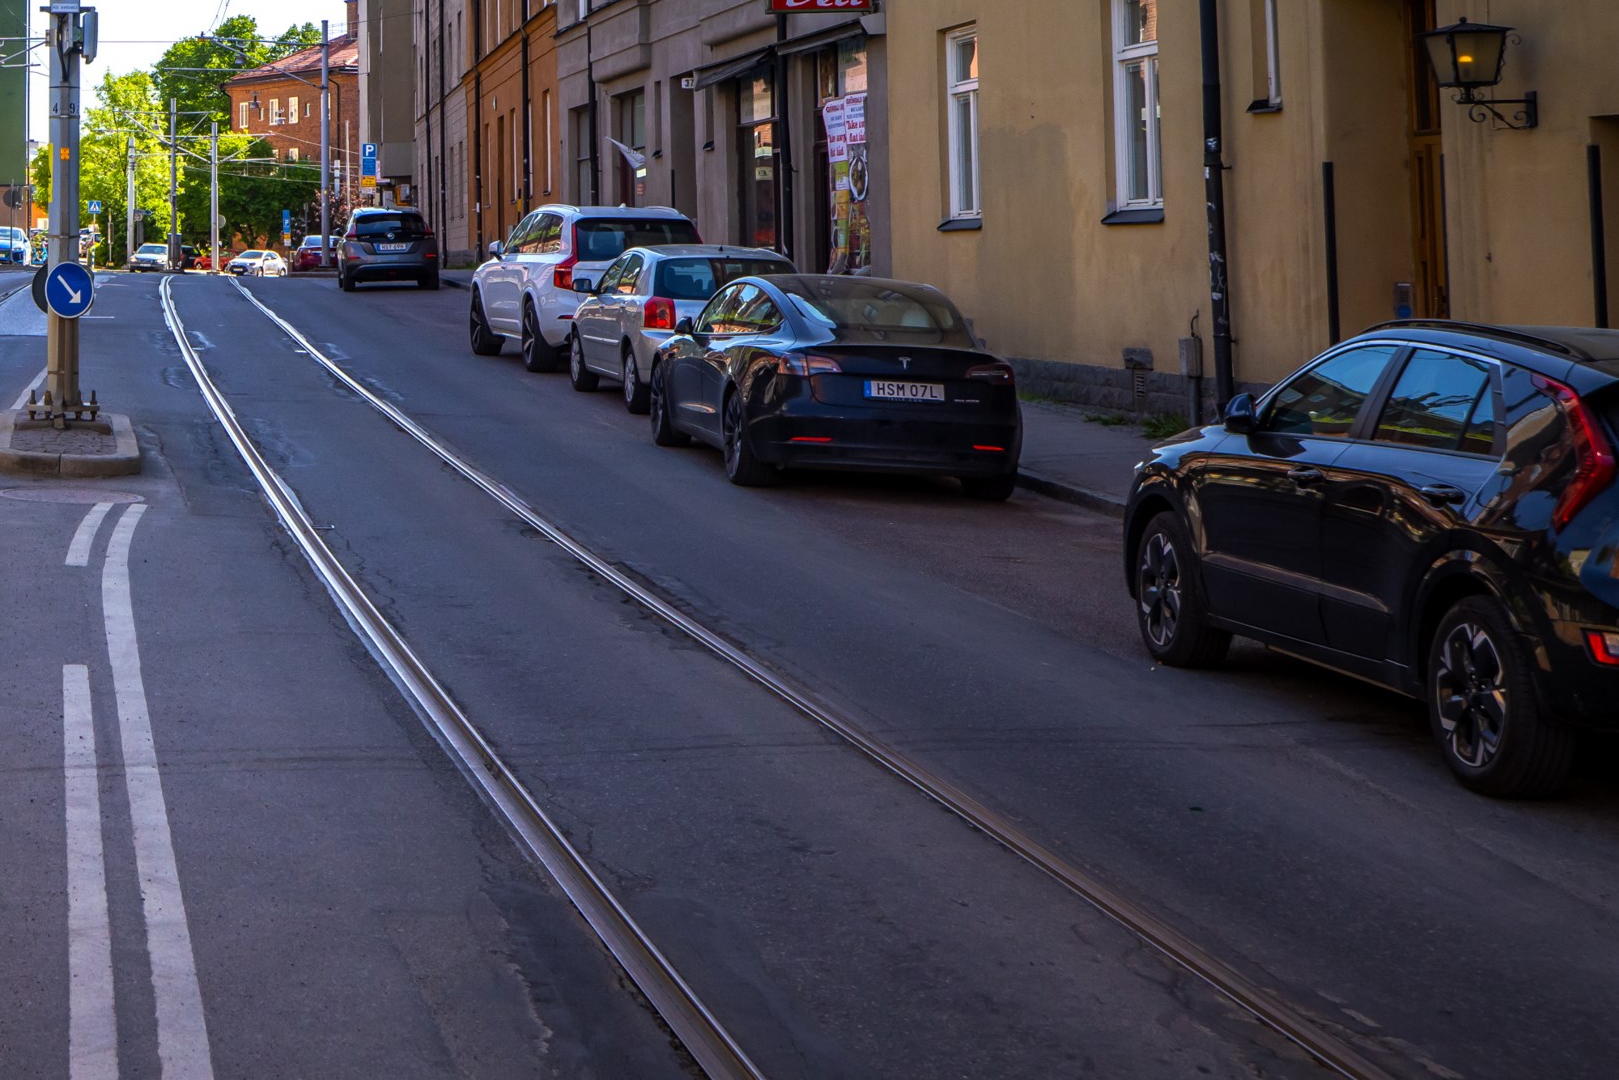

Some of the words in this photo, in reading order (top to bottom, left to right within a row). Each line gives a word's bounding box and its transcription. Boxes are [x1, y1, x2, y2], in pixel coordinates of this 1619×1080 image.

[684, 79, 694, 88] 37
[365, 144, 374, 157] P
[876, 382, 906, 397] HSM
[909, 384, 938, 398] 07L
